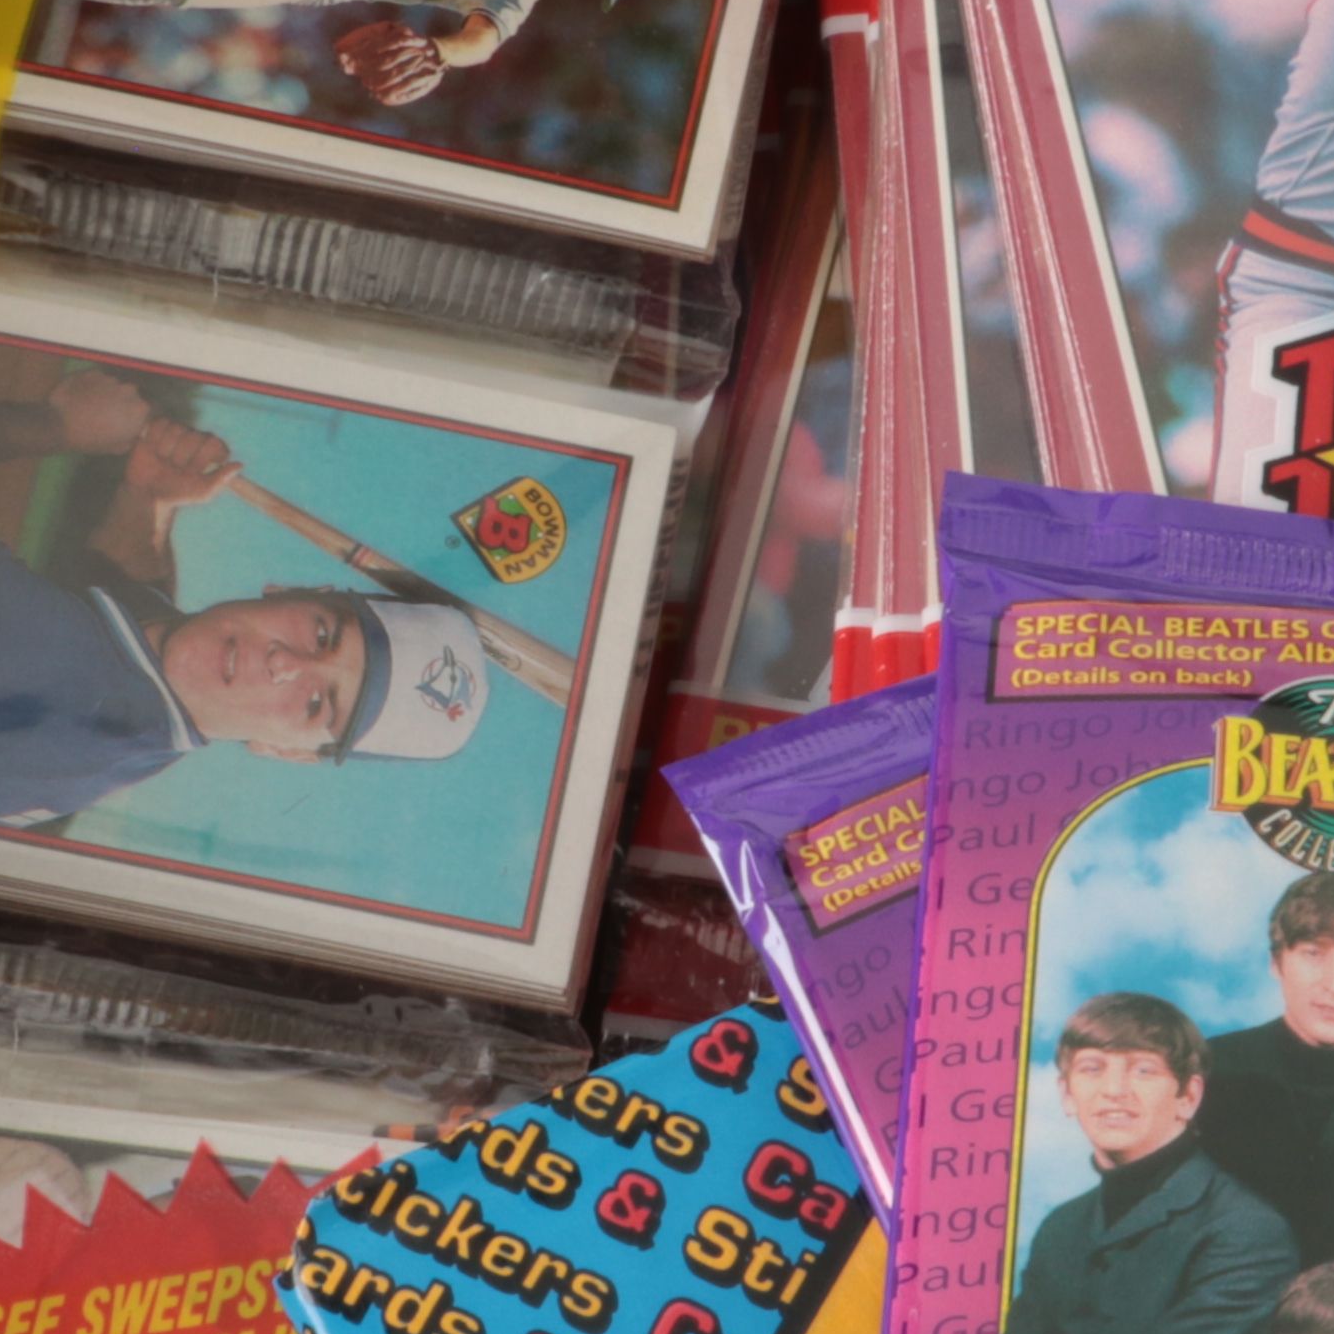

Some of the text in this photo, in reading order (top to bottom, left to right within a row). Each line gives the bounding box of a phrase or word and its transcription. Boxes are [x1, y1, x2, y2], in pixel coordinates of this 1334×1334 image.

[503, 487, 560, 576] BOWMAN
[1012, 638, 1098, 662] Card
[1106, 640, 1267, 664] Collector
[1014, 613, 1154, 640] SPECIAL
[1164, 617, 1309, 641] BEATLES
[1010, 667, 1253, 689] (Details on back)
[799, 798, 927, 868] SPECIAL
[811, 842, 890, 889] Card
[821, 858, 923, 913] (Details
[597, 1170, 661, 1234] &
